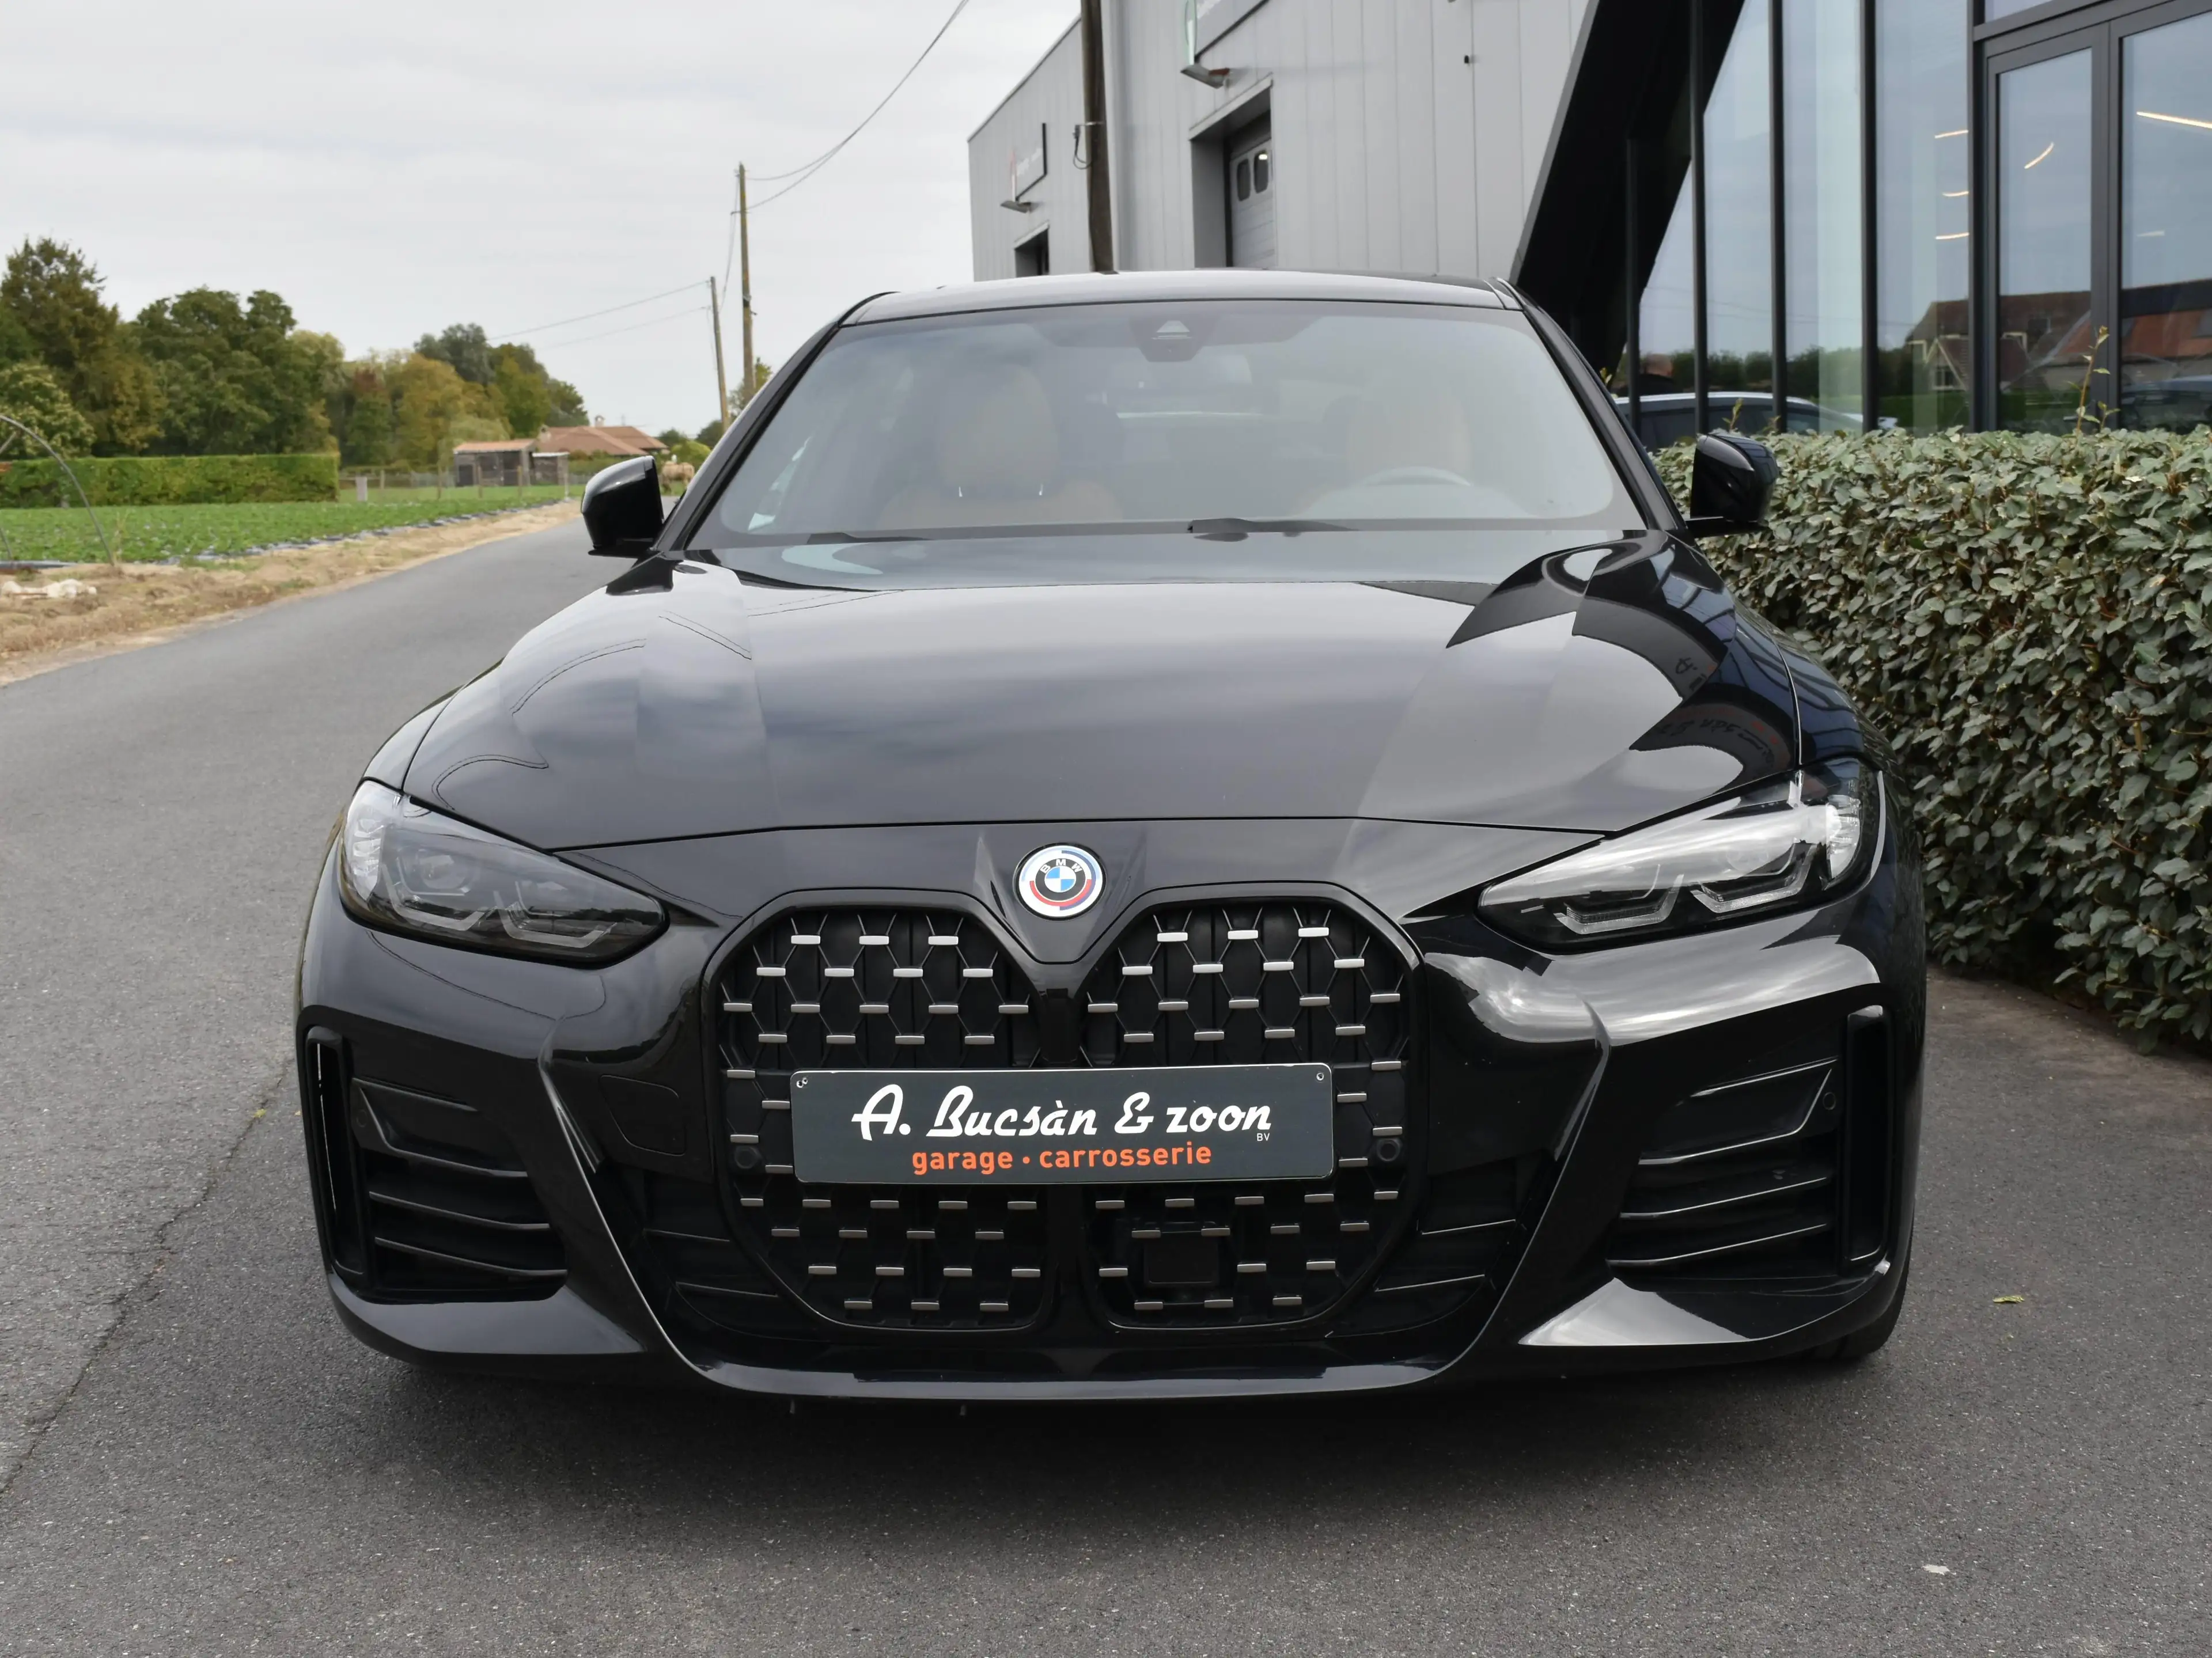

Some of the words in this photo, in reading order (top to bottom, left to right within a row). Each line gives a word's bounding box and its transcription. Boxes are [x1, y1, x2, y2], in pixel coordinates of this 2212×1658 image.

[1040, 859, 1083, 874] BMW
[851, 1084, 911, 1141] A.
[926, 1085, 1097, 1137] Bucsàn
[1114, 1091, 1154, 1134] &
[1166, 1105, 1272, 1133] zoon
[1256, 1133, 1270, 1141] BV
[912, 1151, 1013, 1175] garage
[1039, 1141, 1212, 1168] carrosserie
